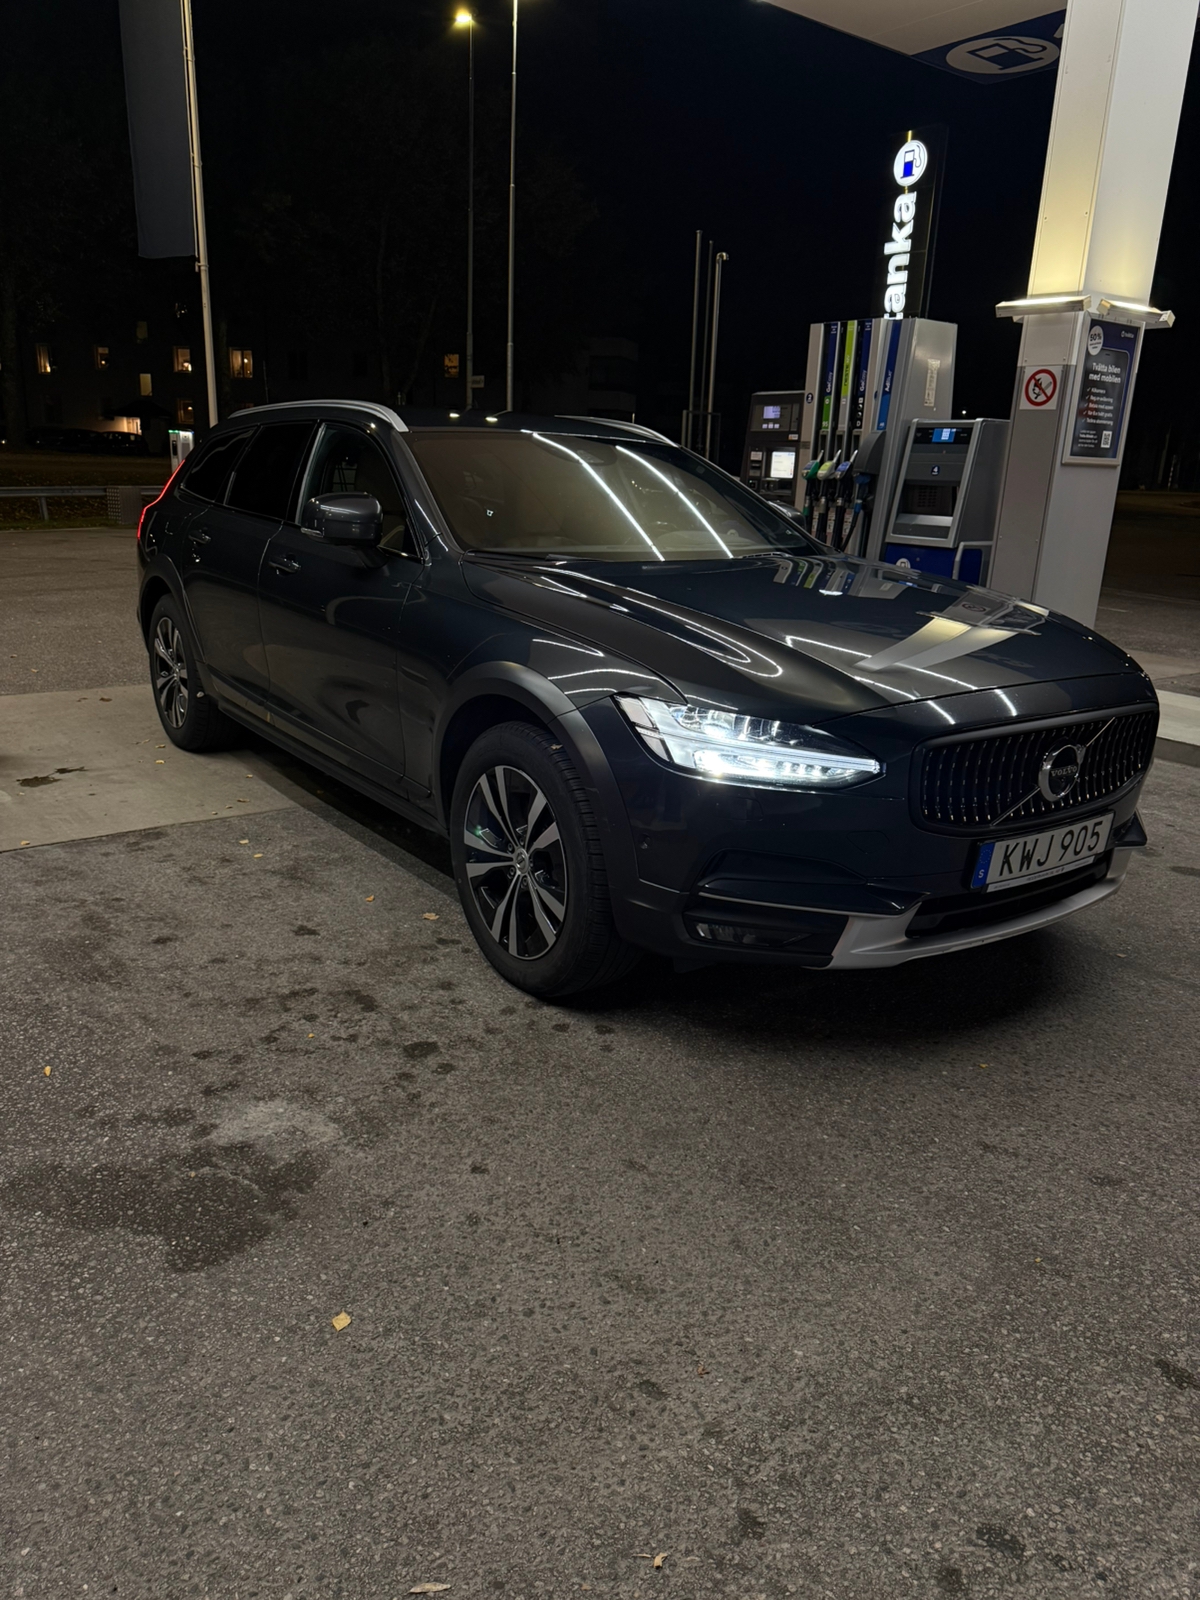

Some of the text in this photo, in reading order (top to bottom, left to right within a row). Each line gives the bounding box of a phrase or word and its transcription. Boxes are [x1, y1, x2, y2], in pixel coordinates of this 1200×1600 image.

[1090, 333, 1102, 341] 50%
[1092, 362, 1121, 374] Tvätta bilen
[1089, 373, 1121, 384] med mobilen
[1051, 766, 1077, 777] VOLVO
[999, 821, 1103, 877] KWJ 905
[978, 869, 984, 878] S
